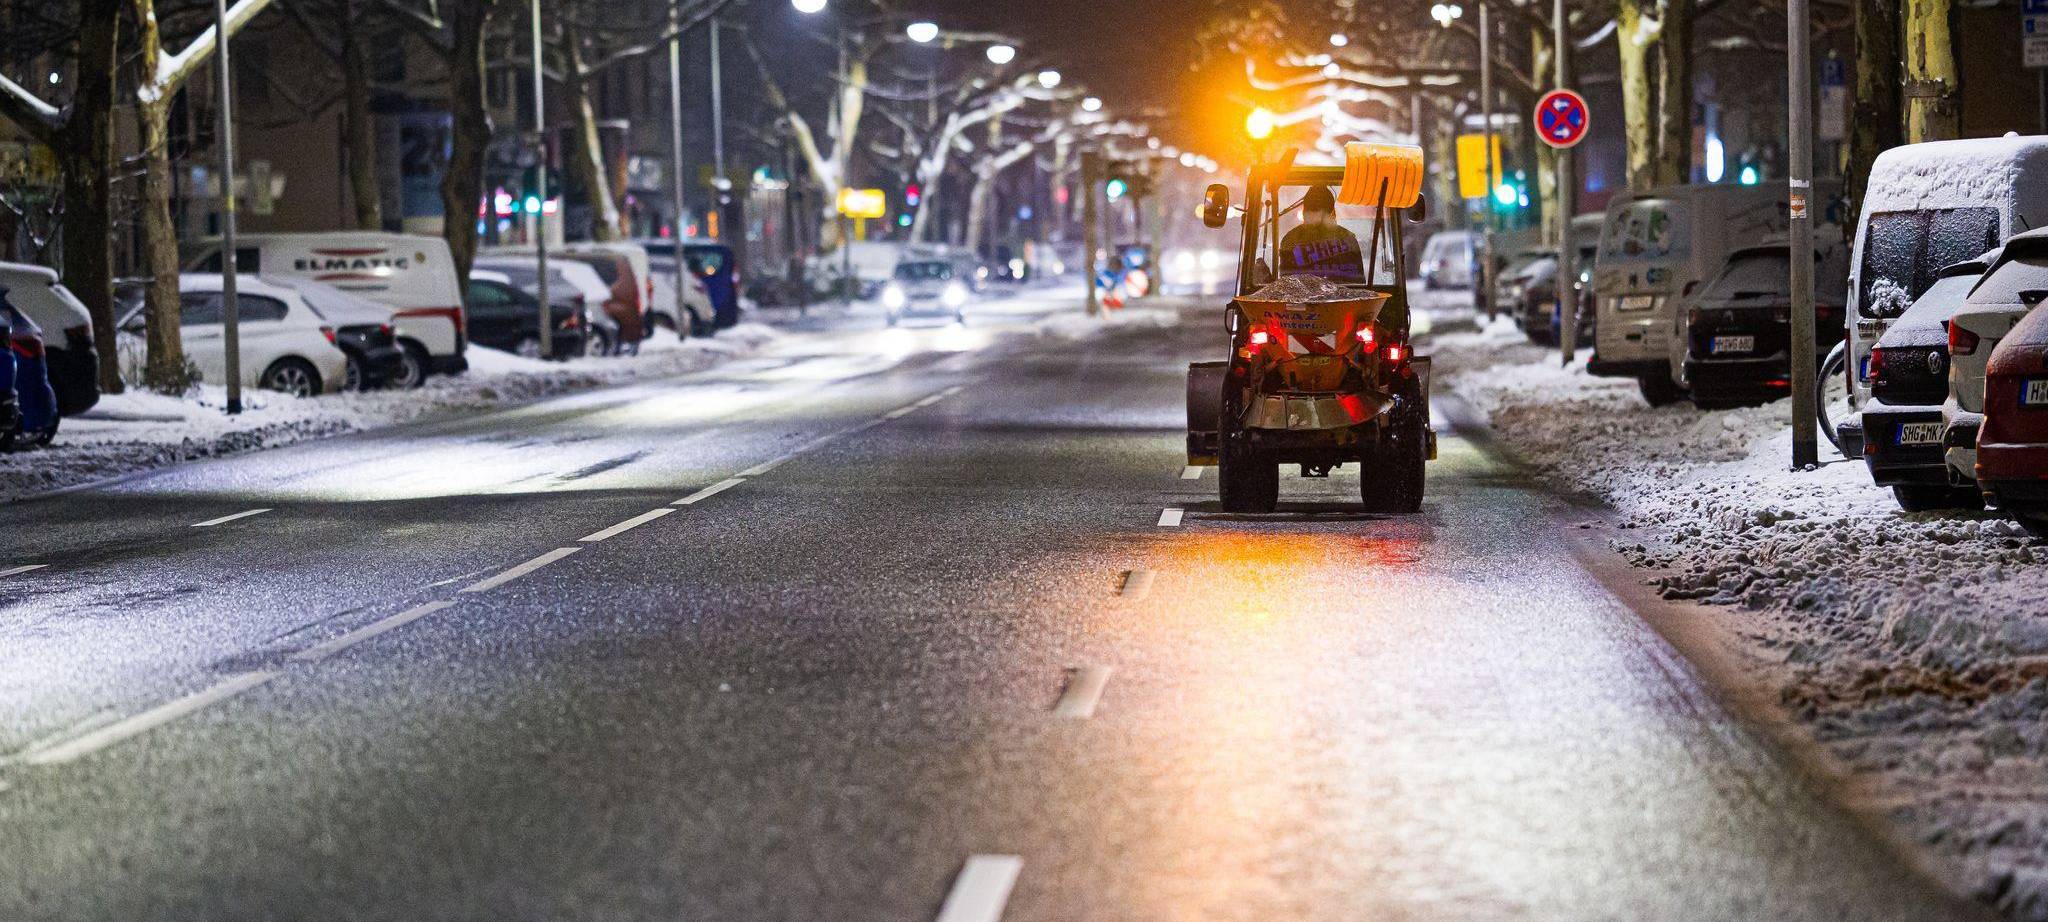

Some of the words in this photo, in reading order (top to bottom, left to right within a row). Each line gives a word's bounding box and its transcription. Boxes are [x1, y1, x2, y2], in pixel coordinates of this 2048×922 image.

[2030, 383, 2040, 401] H
[1902, 425, 1920, 442] SHG
[1925, 424, 1939, 441] MK
